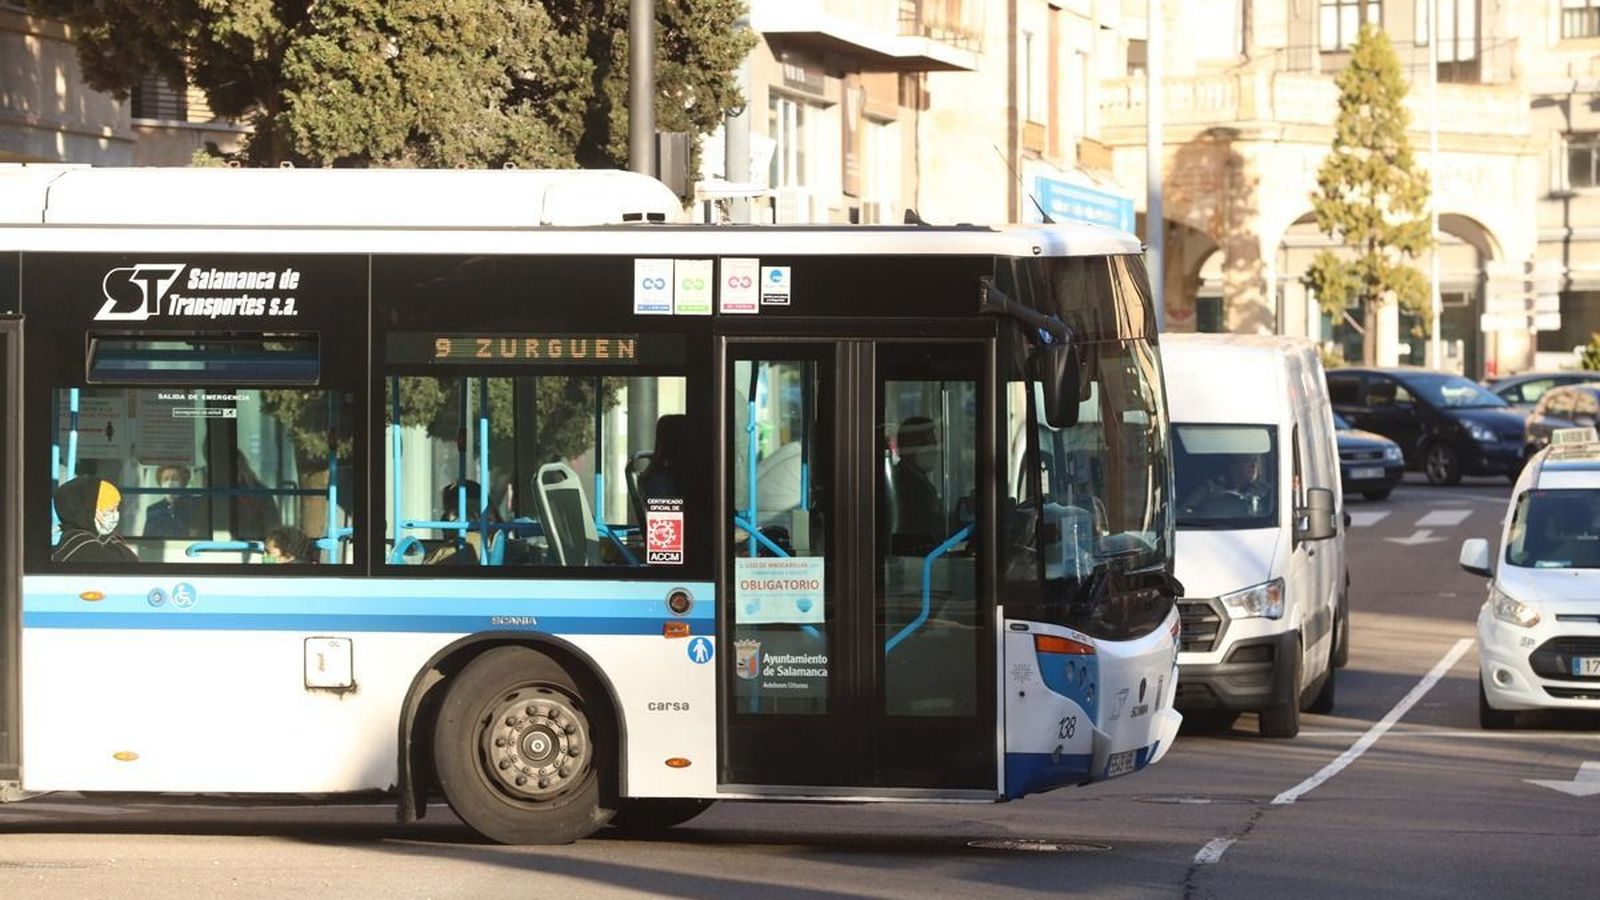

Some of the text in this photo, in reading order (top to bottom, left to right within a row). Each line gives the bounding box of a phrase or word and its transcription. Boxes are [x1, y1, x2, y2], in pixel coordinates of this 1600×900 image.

[187, 268, 300, 290] Salamanca de
[168, 294, 298, 319] Transportes s.a.
[435, 338, 635, 358] 9 ZURGUEN
[650, 553, 680, 561] ACCM
[740, 579, 820, 591] OBLIGATORIO
[492, 616, 538, 625] SCANIA
[763, 653, 828, 666] Ayuntamiento
[763, 666, 828, 677] de Salamanca
[647, 702, 690, 711] carsa
[1058, 716, 1077, 739] 138
